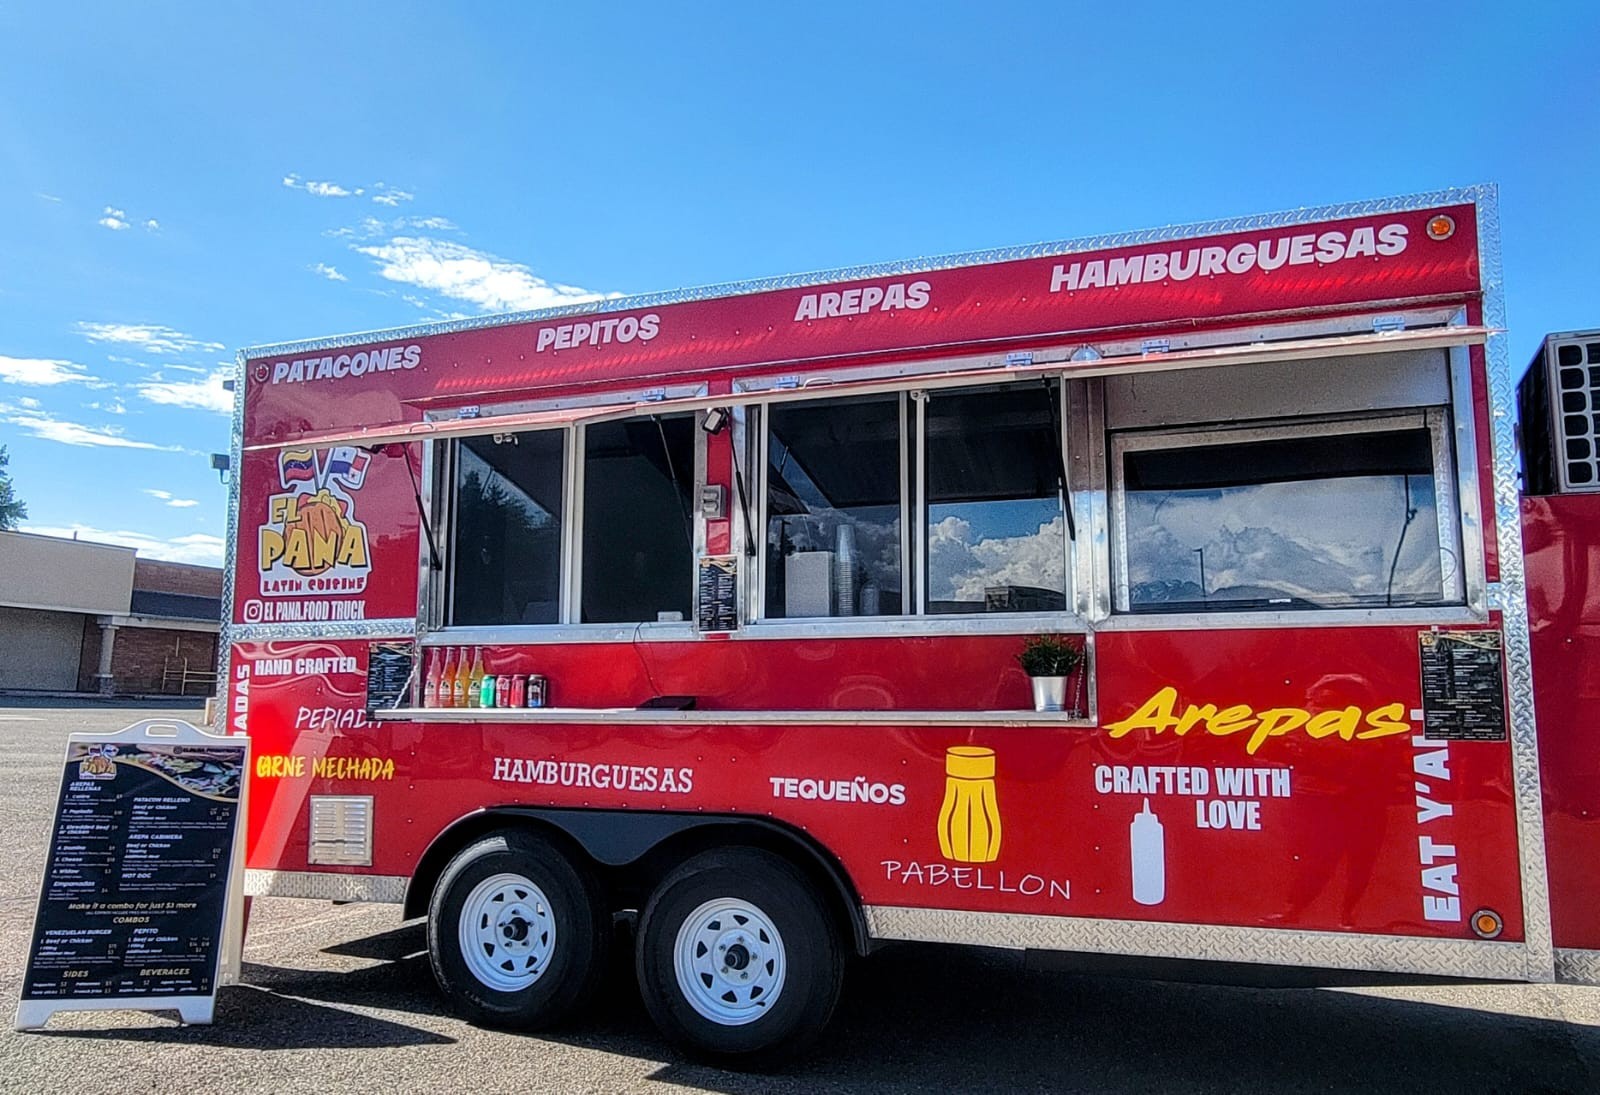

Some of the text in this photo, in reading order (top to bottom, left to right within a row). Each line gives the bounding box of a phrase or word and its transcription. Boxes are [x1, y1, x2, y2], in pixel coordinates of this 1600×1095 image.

[1049, 223, 1410, 293] HAMBURGUESAS
[793, 280, 932, 322] AREPAS
[536, 313, 661, 353] PEPITOS
[272, 344, 422, 385] PATACONES
[271, 496, 302, 524] EL
[261, 525, 368, 571] PANA
[263, 579, 302, 592] LATIN
[263, 601, 274, 621] EL
[331, 600, 366, 620] TRUCK
[254, 656, 357, 676] HAND CRAFTED
[295, 706, 382, 729] PEPIAD
[1102, 686, 1412, 755] Arepas
[312, 756, 395, 781] MECHADA
[492, 757, 694, 793] HAMBURGUESAS
[1094, 765, 1292, 798] CRAFTED WITH
[769, 776, 907, 806] TEQUEÑOS
[1196, 799, 1262, 830] LOVE
[881, 860, 1071, 900] PABELLON
[1418, 835, 1462, 922] EAT
[91, 901, 99, 909] it
[135, 901, 149, 910] for
[148, 901, 165, 910] just
[62, 970, 89, 978] SIDES
